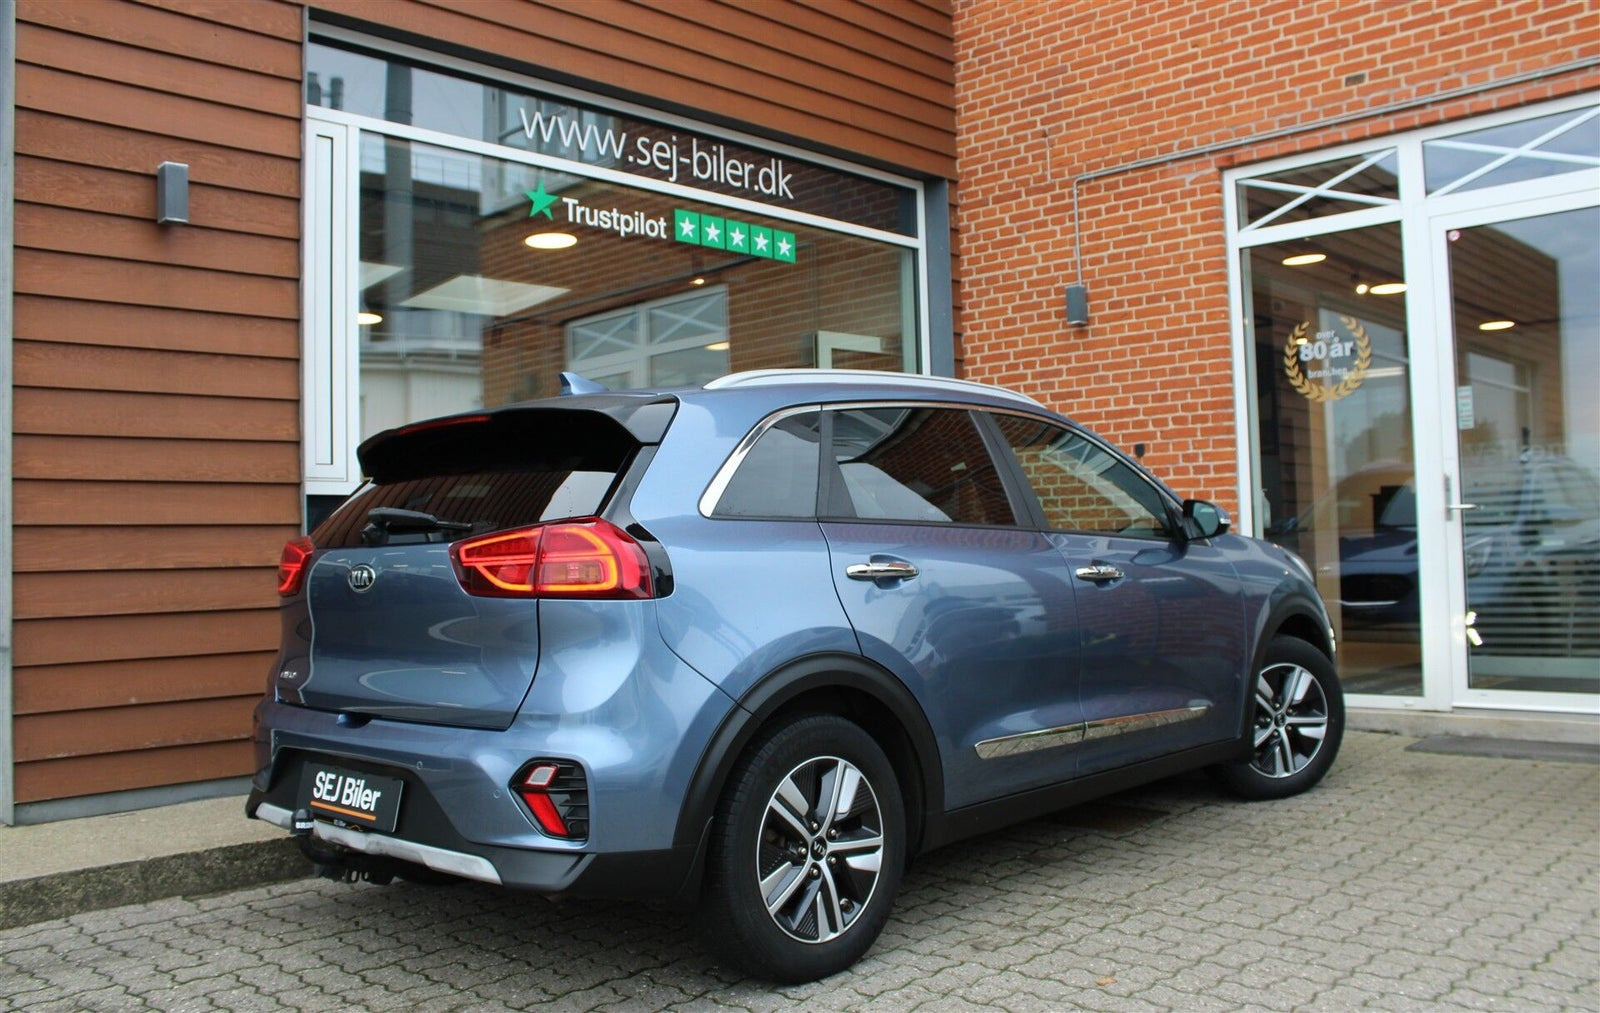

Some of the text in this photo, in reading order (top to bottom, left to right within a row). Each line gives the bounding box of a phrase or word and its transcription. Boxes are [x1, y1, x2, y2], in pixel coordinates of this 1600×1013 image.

[520, 107, 794, 200] www.sej-biler.dk
[562, 197, 667, 239] Trustpilot
[1299, 336, 1354, 362] 80 år
[313, 771, 382, 811] SEJ Biler
